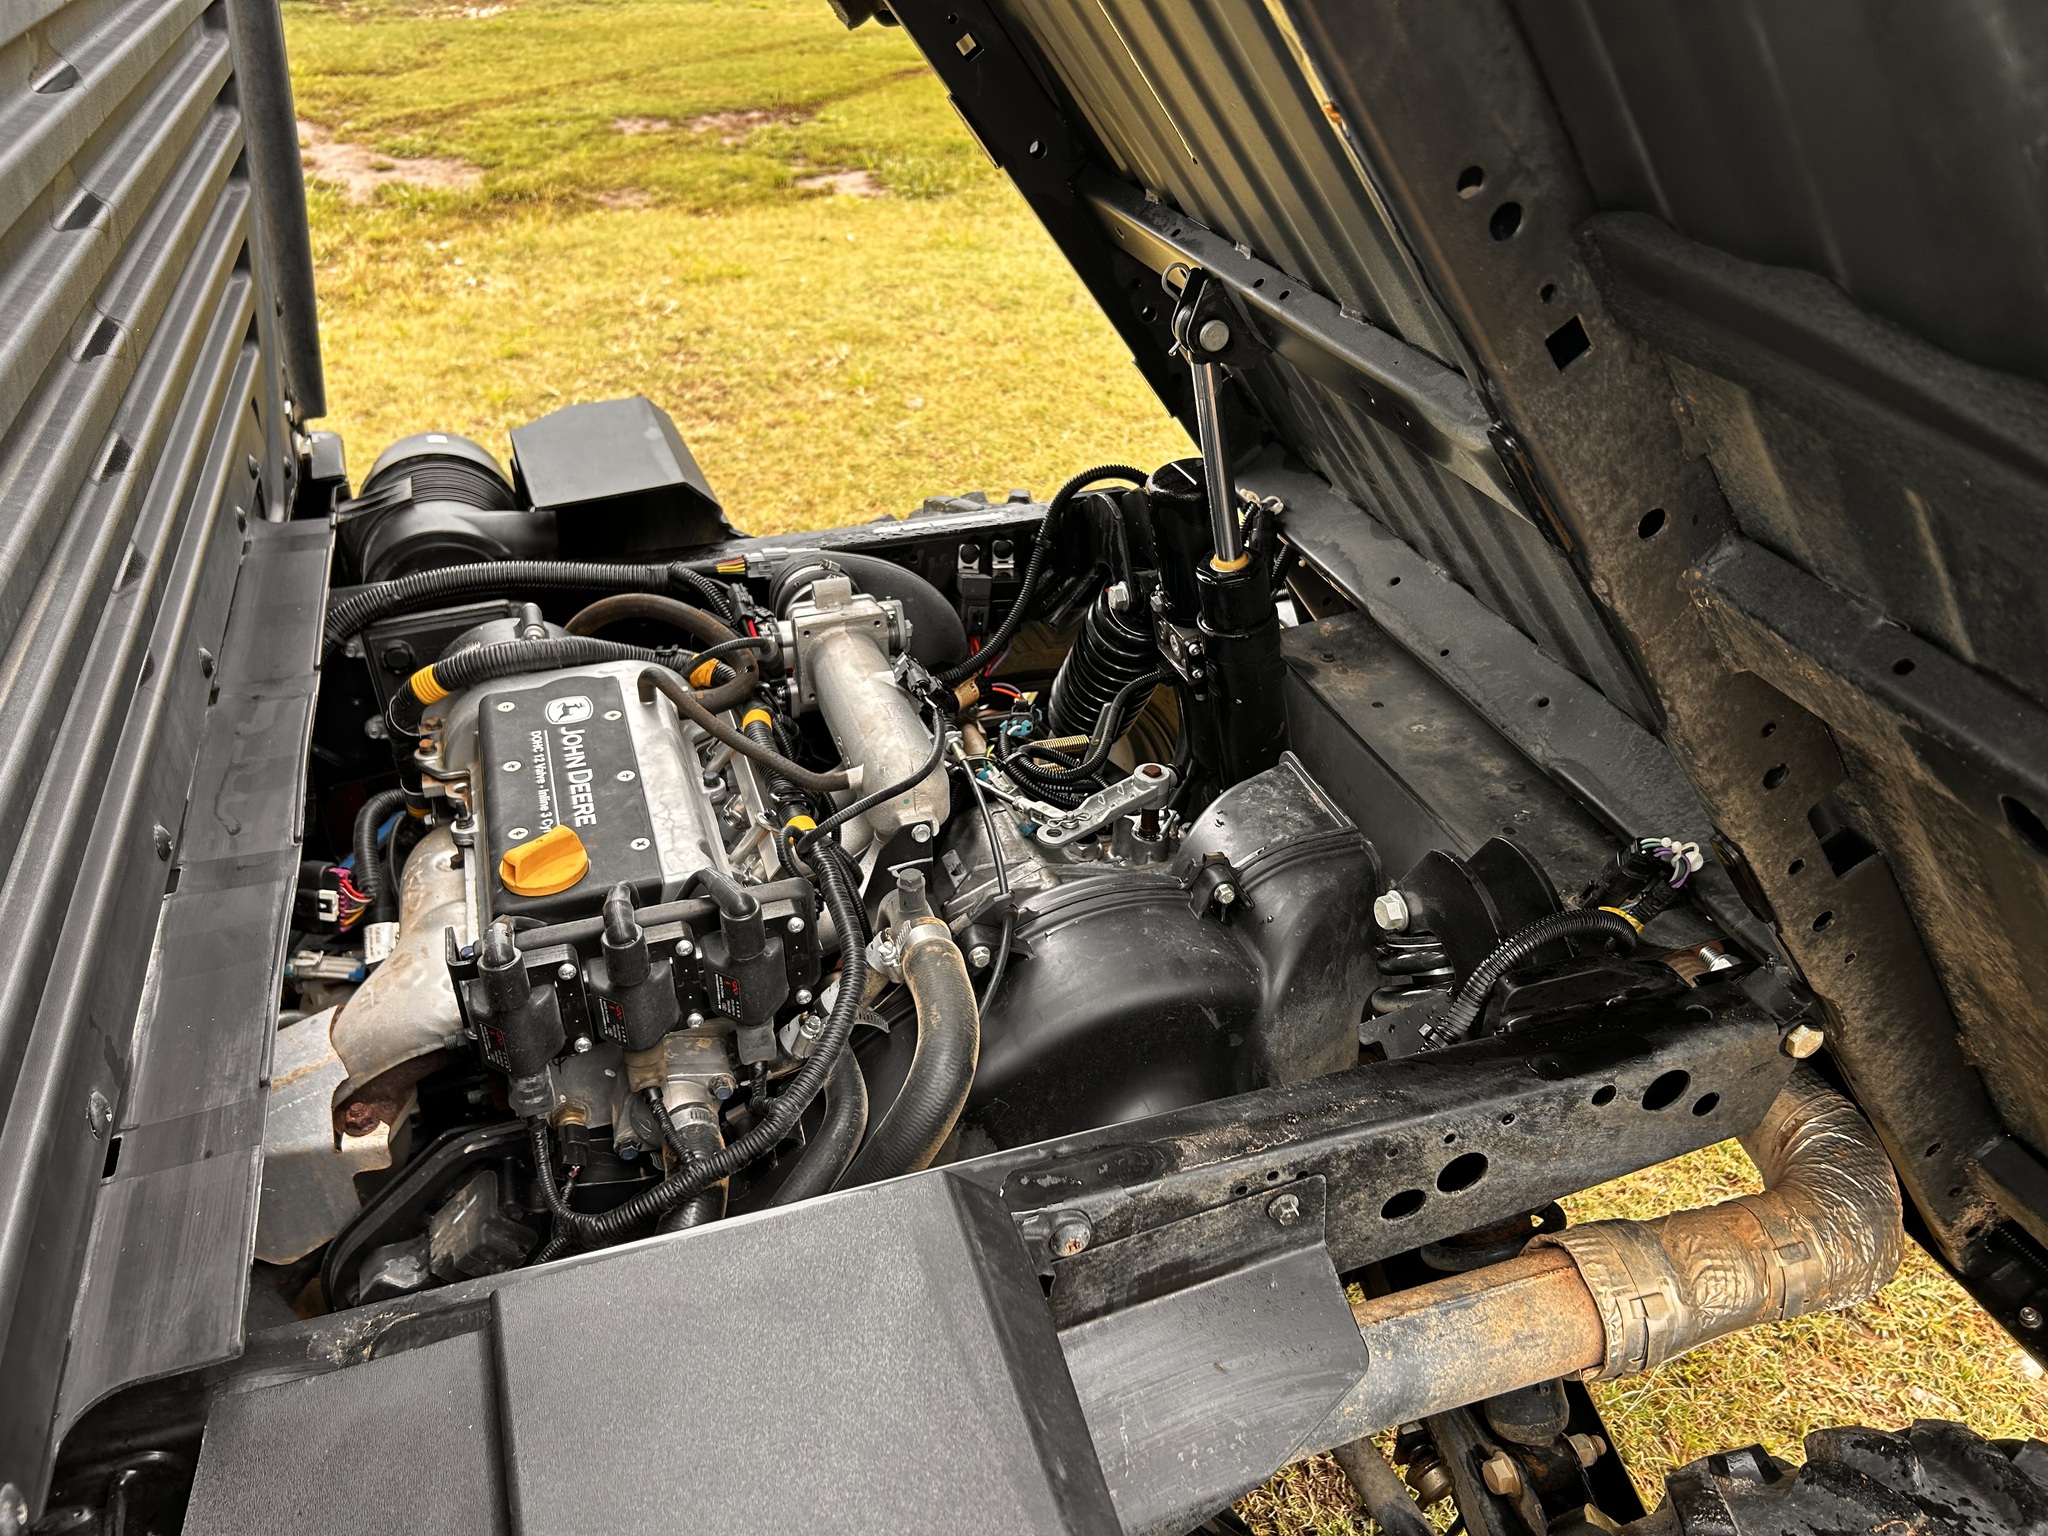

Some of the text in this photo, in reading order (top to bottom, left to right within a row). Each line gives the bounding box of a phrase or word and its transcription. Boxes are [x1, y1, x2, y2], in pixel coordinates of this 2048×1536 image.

[531, 730, 545, 753] DOHC
[533, 753, 545, 763] 12
[534, 763, 547, 784] Valve
[560, 727, 597, 827] JOHN DEERE
[538, 789, 551, 812] Inline
